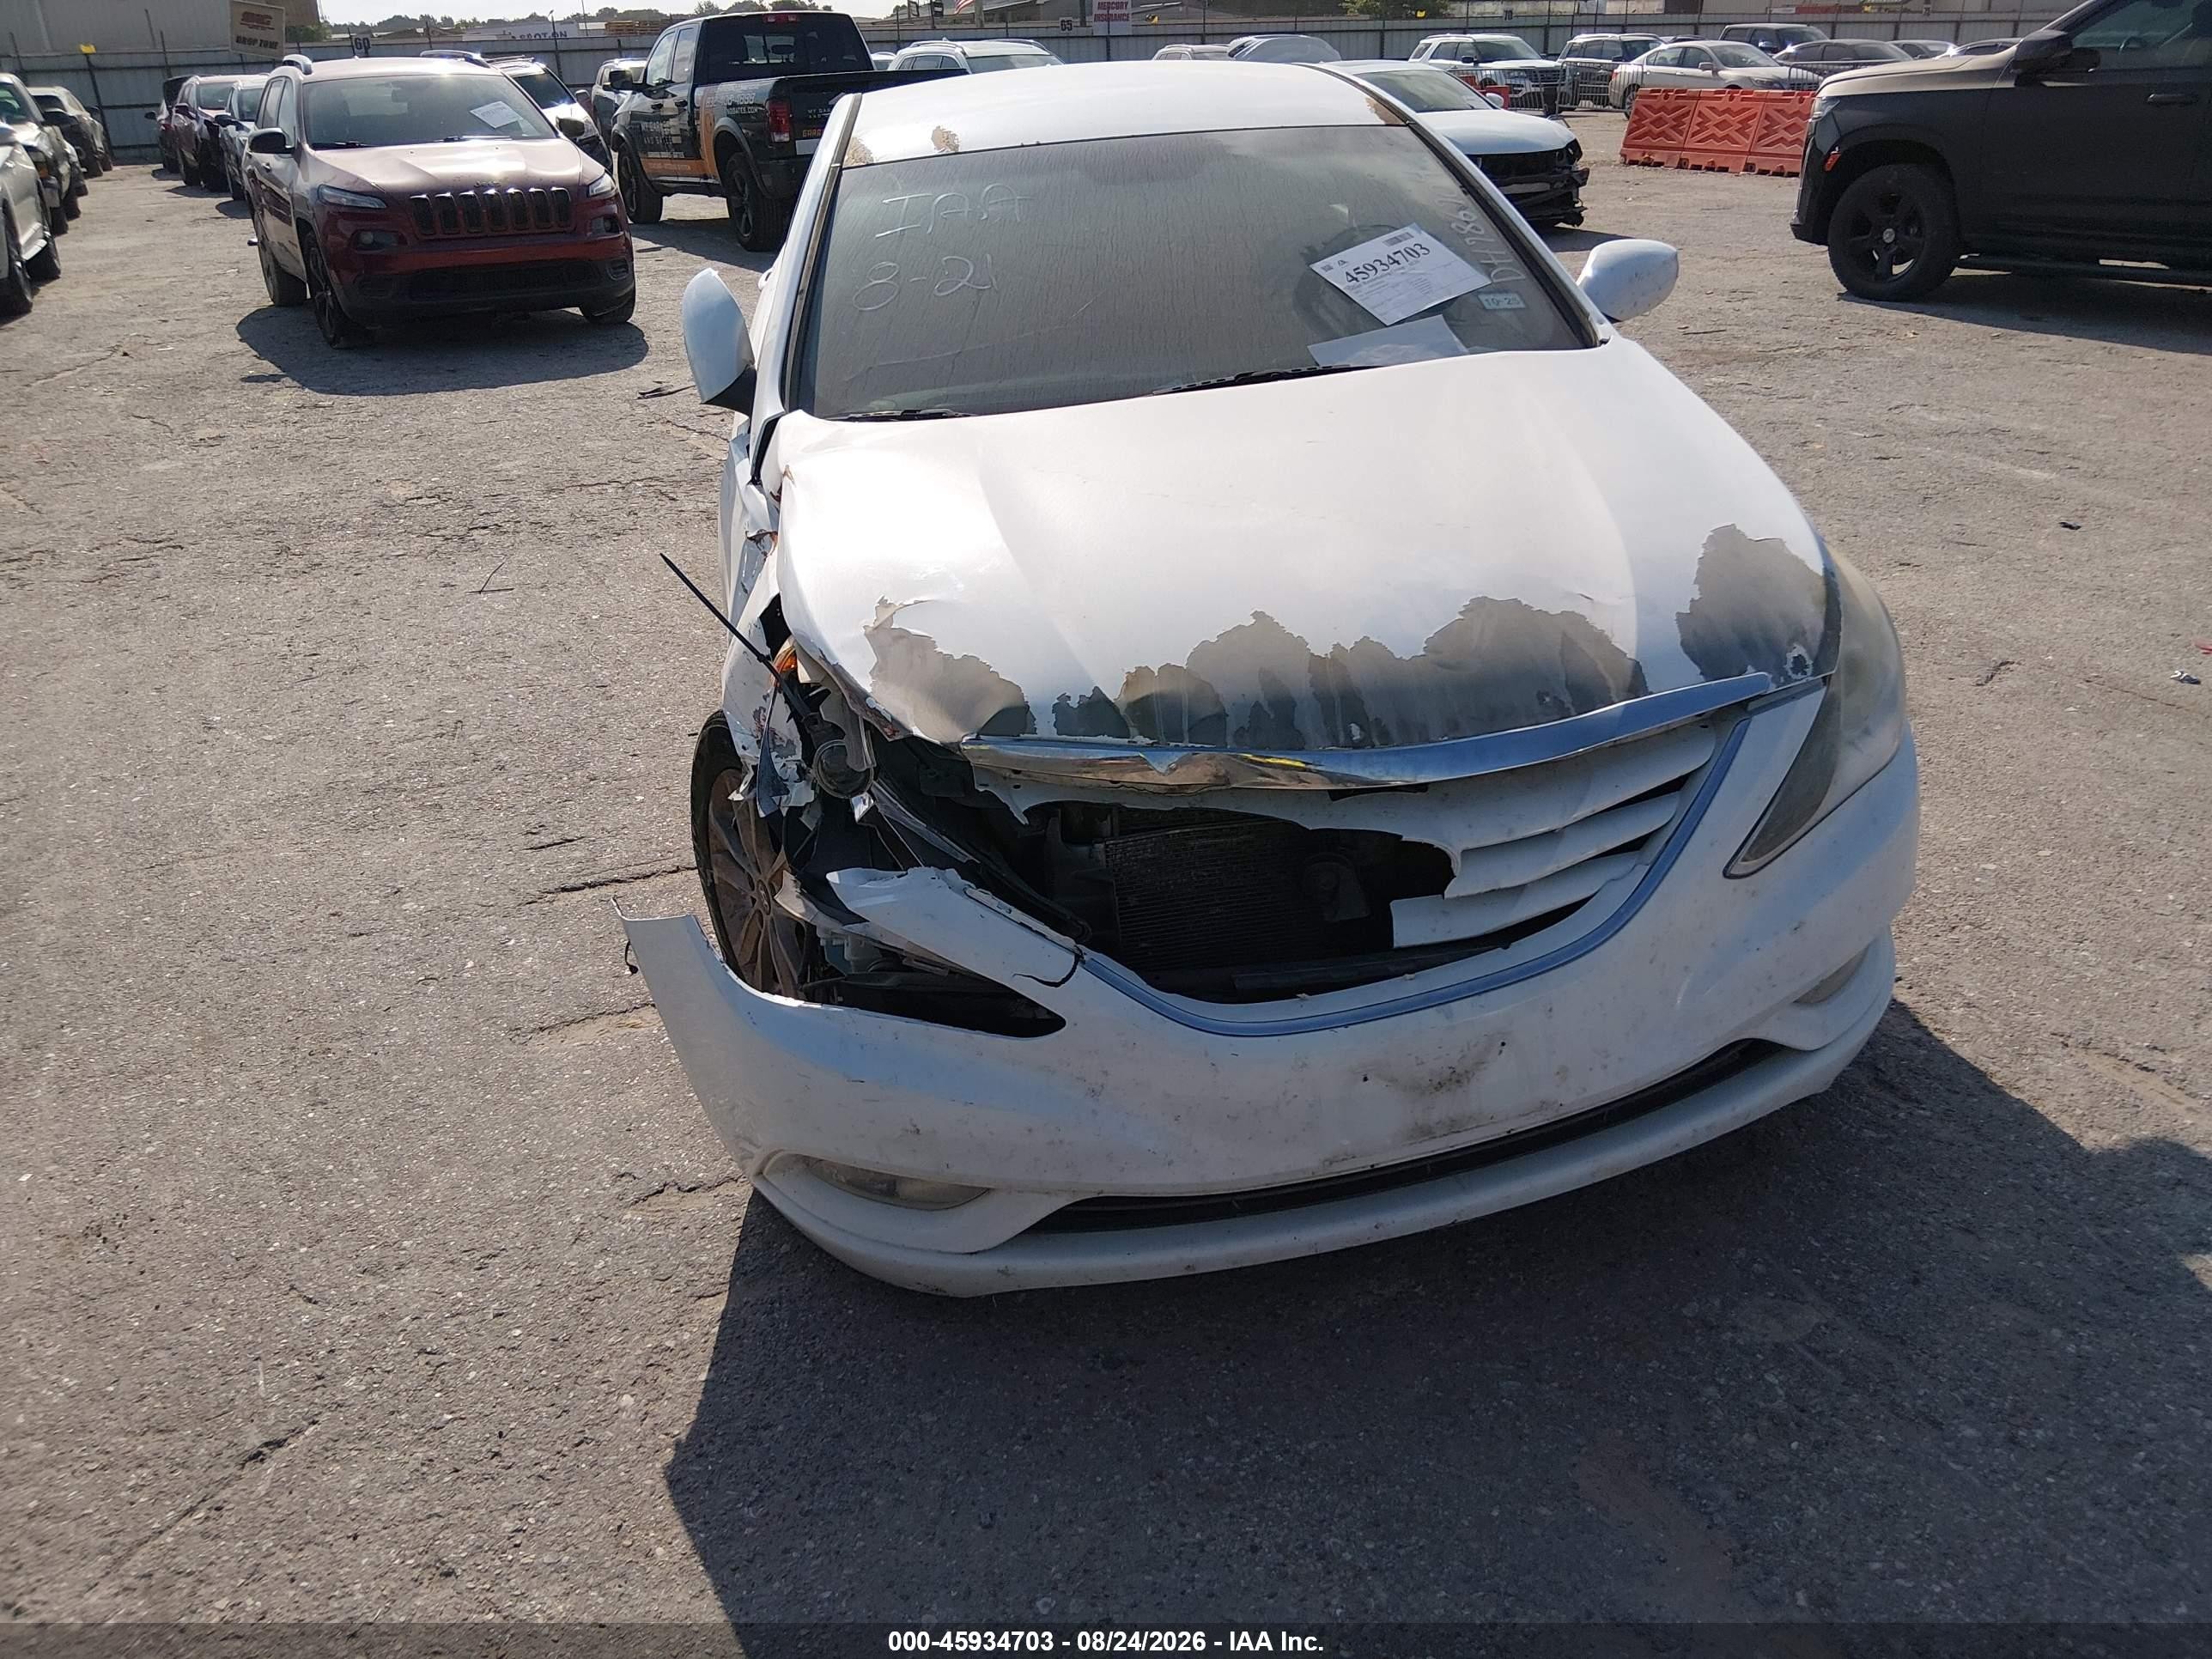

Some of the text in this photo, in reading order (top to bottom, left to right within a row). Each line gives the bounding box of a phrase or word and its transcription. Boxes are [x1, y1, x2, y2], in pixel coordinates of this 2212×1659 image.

[1098, 2, 1127, 10] MERCURY
[1094, 13, 1129, 22] INSURANCE
[1060, 20, 1073, 31] 65
[875, 183, 1034, 238] IAA
[1345, 243, 1431, 283] 45934703
